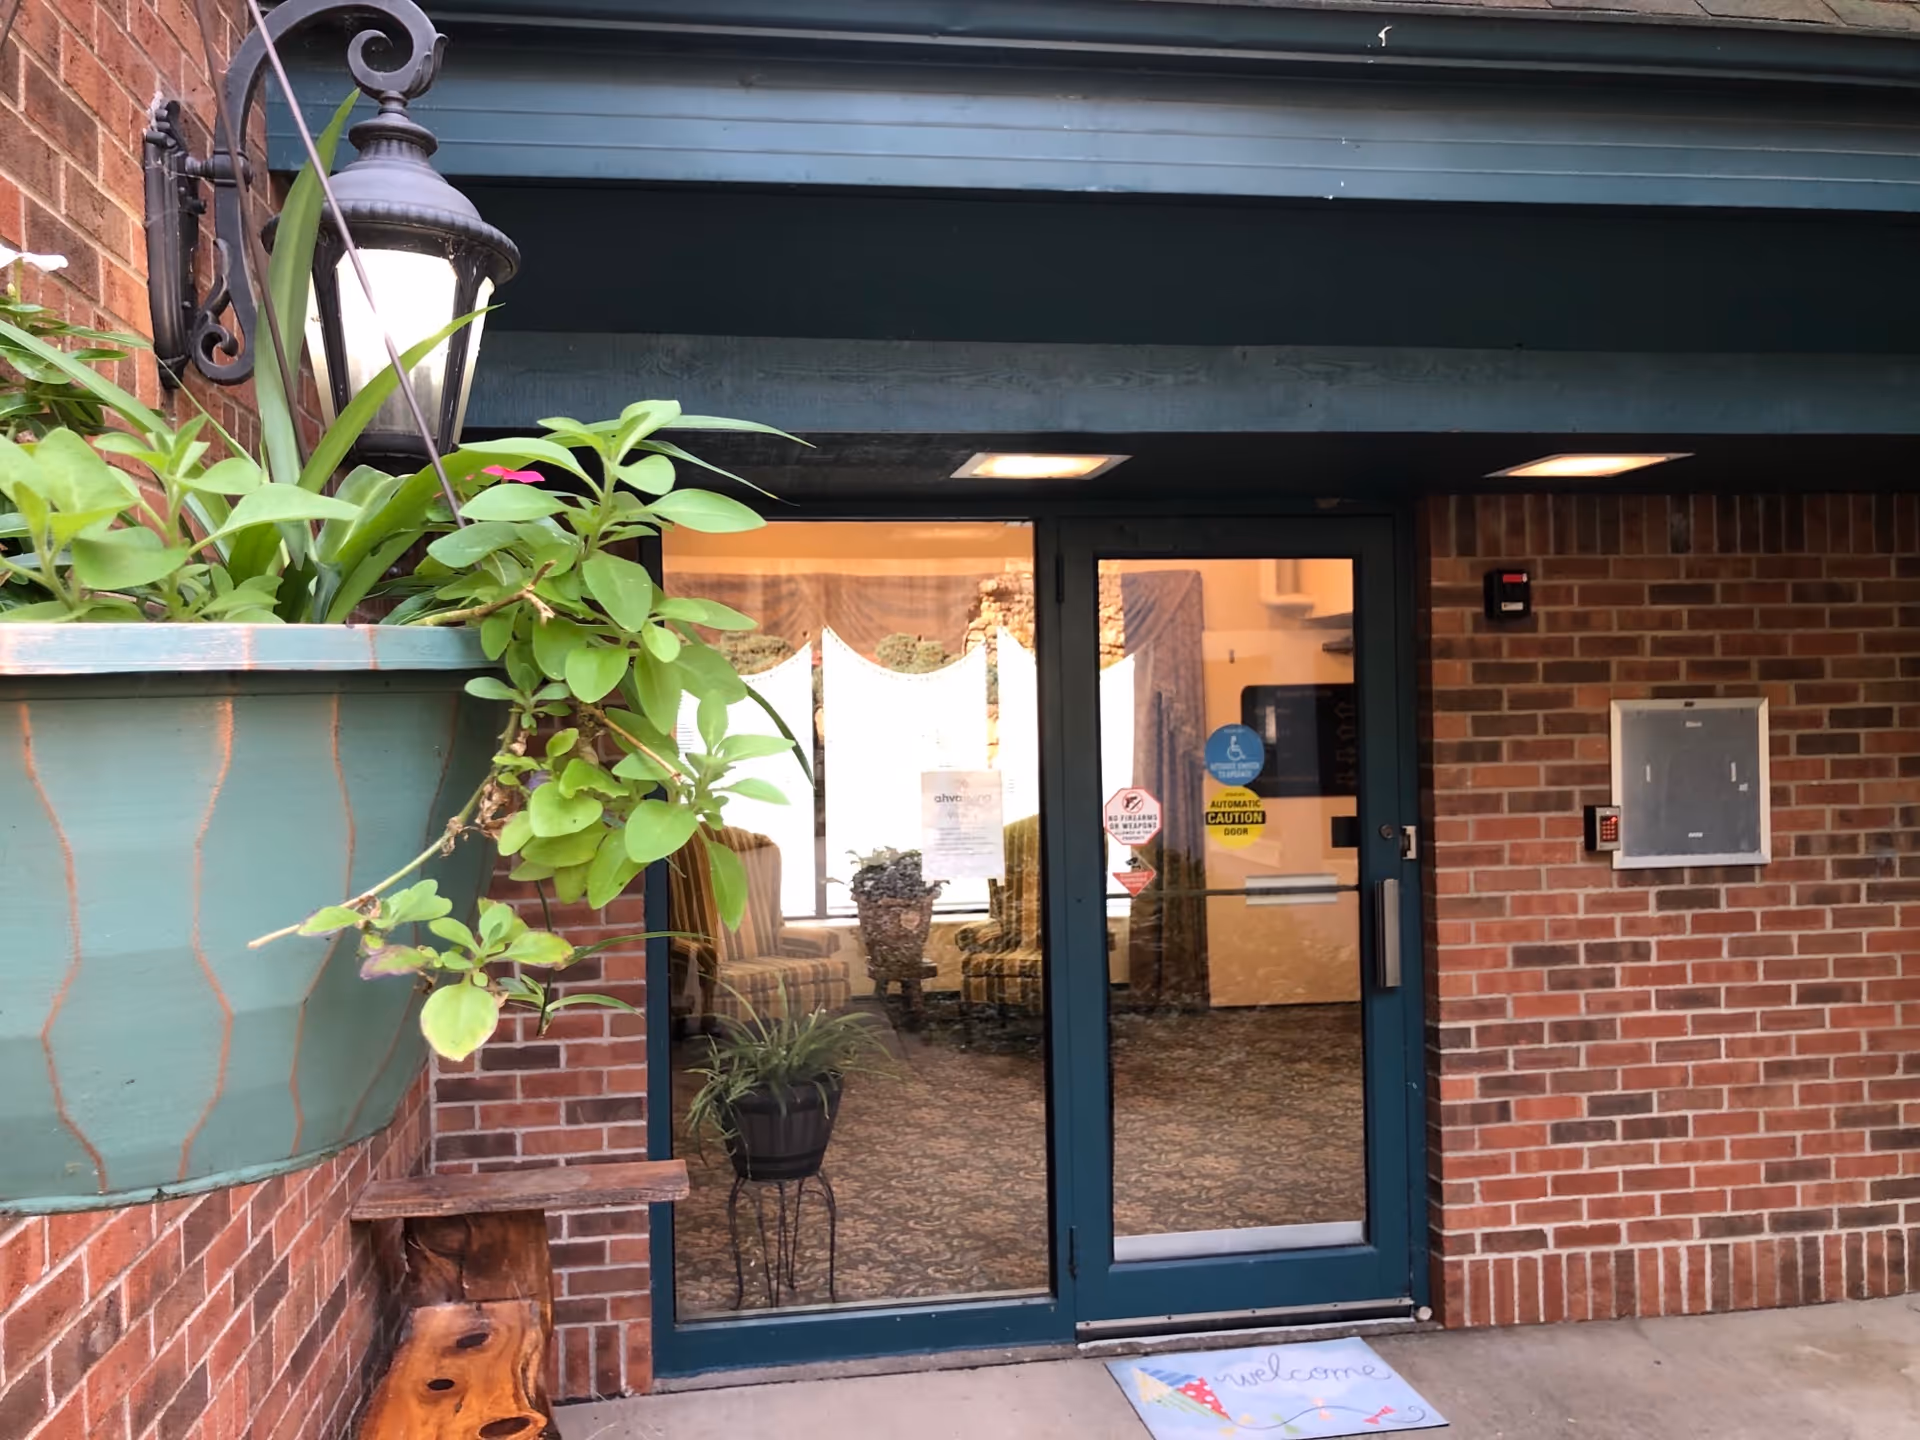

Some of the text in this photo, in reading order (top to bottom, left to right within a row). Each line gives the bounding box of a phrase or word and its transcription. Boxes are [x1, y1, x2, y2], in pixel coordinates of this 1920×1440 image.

[1210, 800, 1261, 809] AUTOMATIC
[1207, 811, 1263, 824] CAUTION
[1109, 822, 1119, 830] OR
[1224, 827, 1248, 836] DOOR
[1213, 1352, 1391, 1387] welcome
